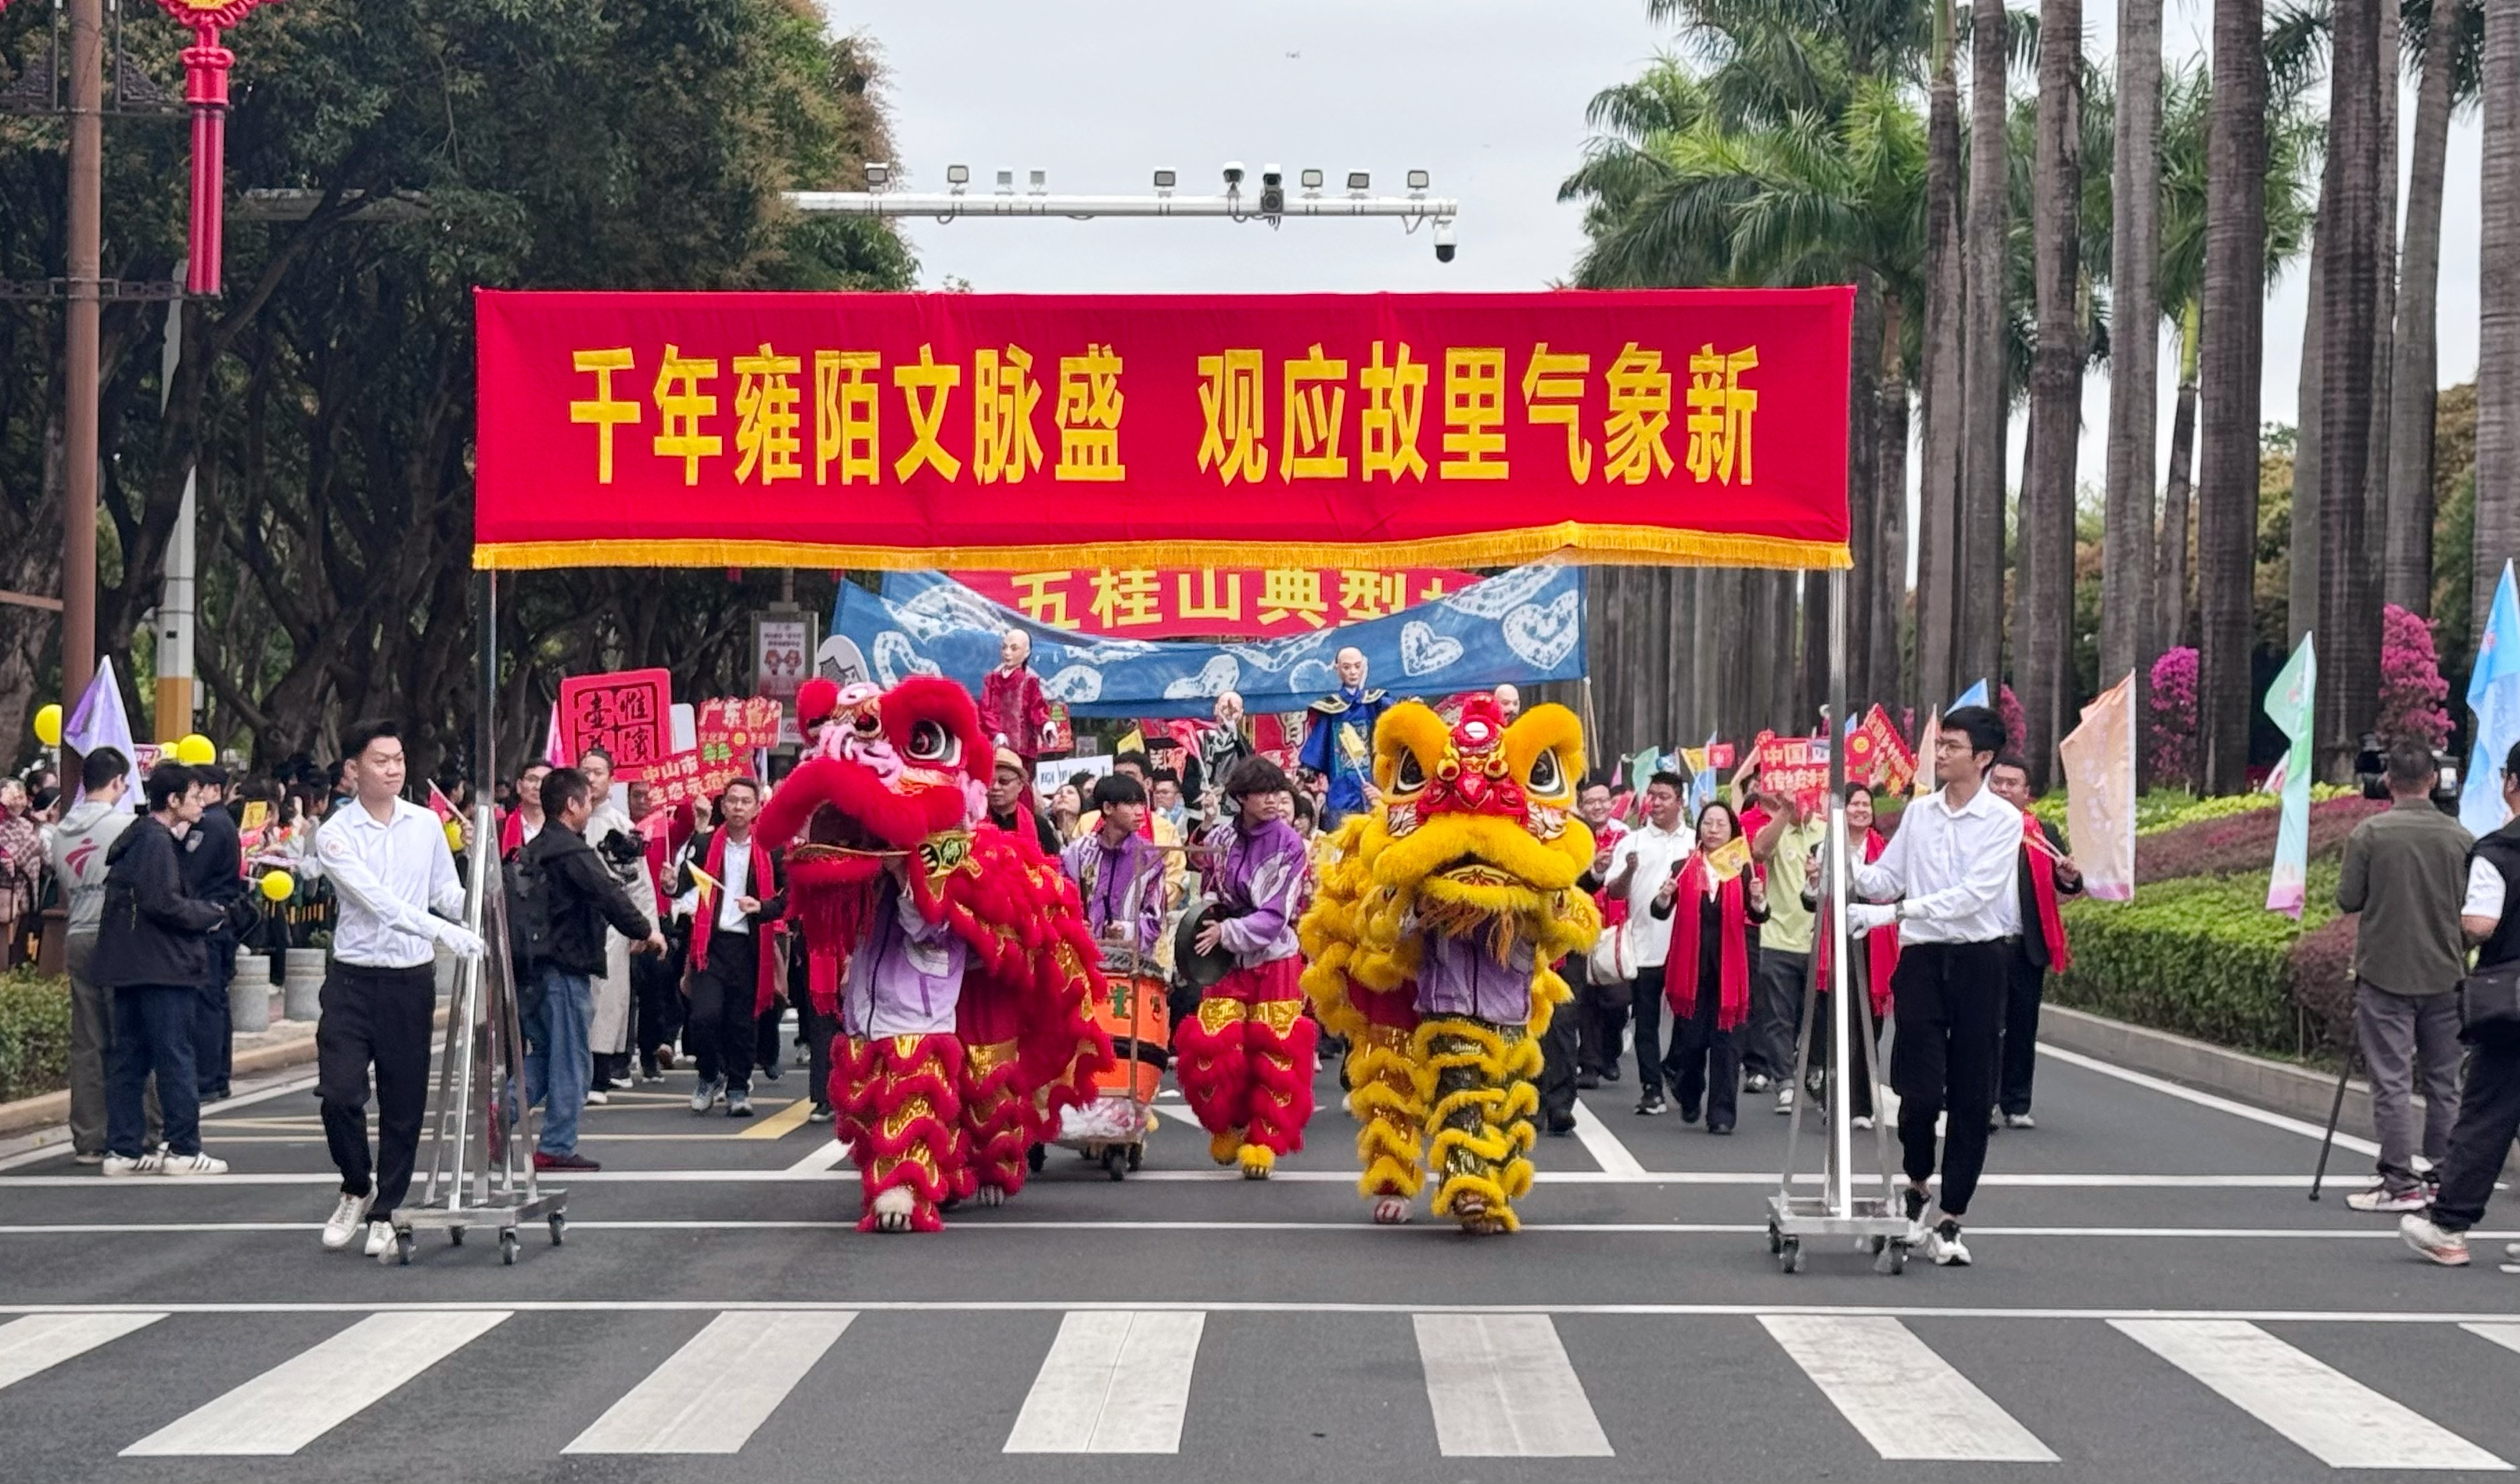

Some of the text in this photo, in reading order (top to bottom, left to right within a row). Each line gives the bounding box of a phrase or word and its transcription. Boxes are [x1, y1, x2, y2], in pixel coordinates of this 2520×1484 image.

[570, 340, 1758, 487] 千年雍陌文脉盛 观应故里气象新
[641, 754, 699, 784] 中山市
[1762, 742, 1809, 767] 中国
